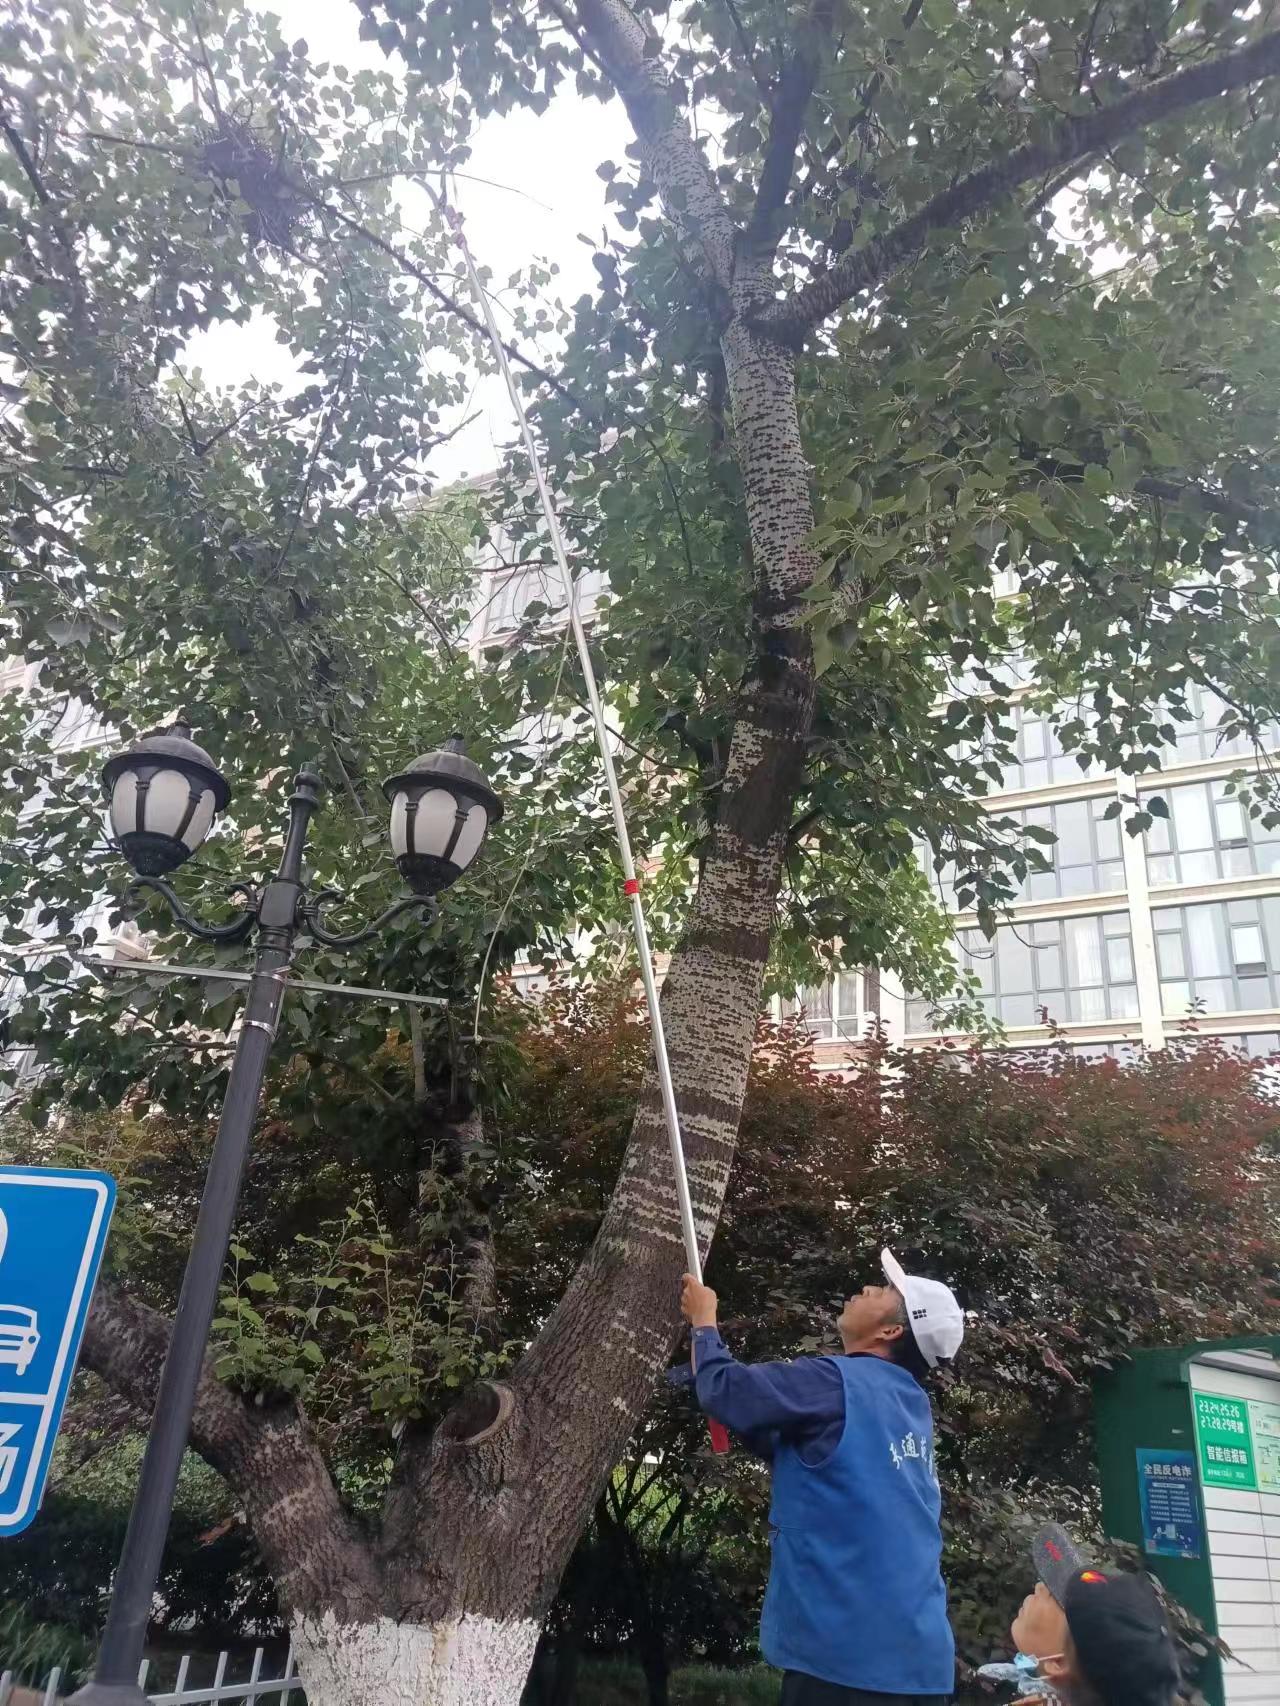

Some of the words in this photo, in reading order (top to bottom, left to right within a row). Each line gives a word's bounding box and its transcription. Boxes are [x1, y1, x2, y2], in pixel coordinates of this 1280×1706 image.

[1206, 1444, 1248, 1465] 智能信报箱
[1143, 1463, 1192, 1478] 全民反电诈
